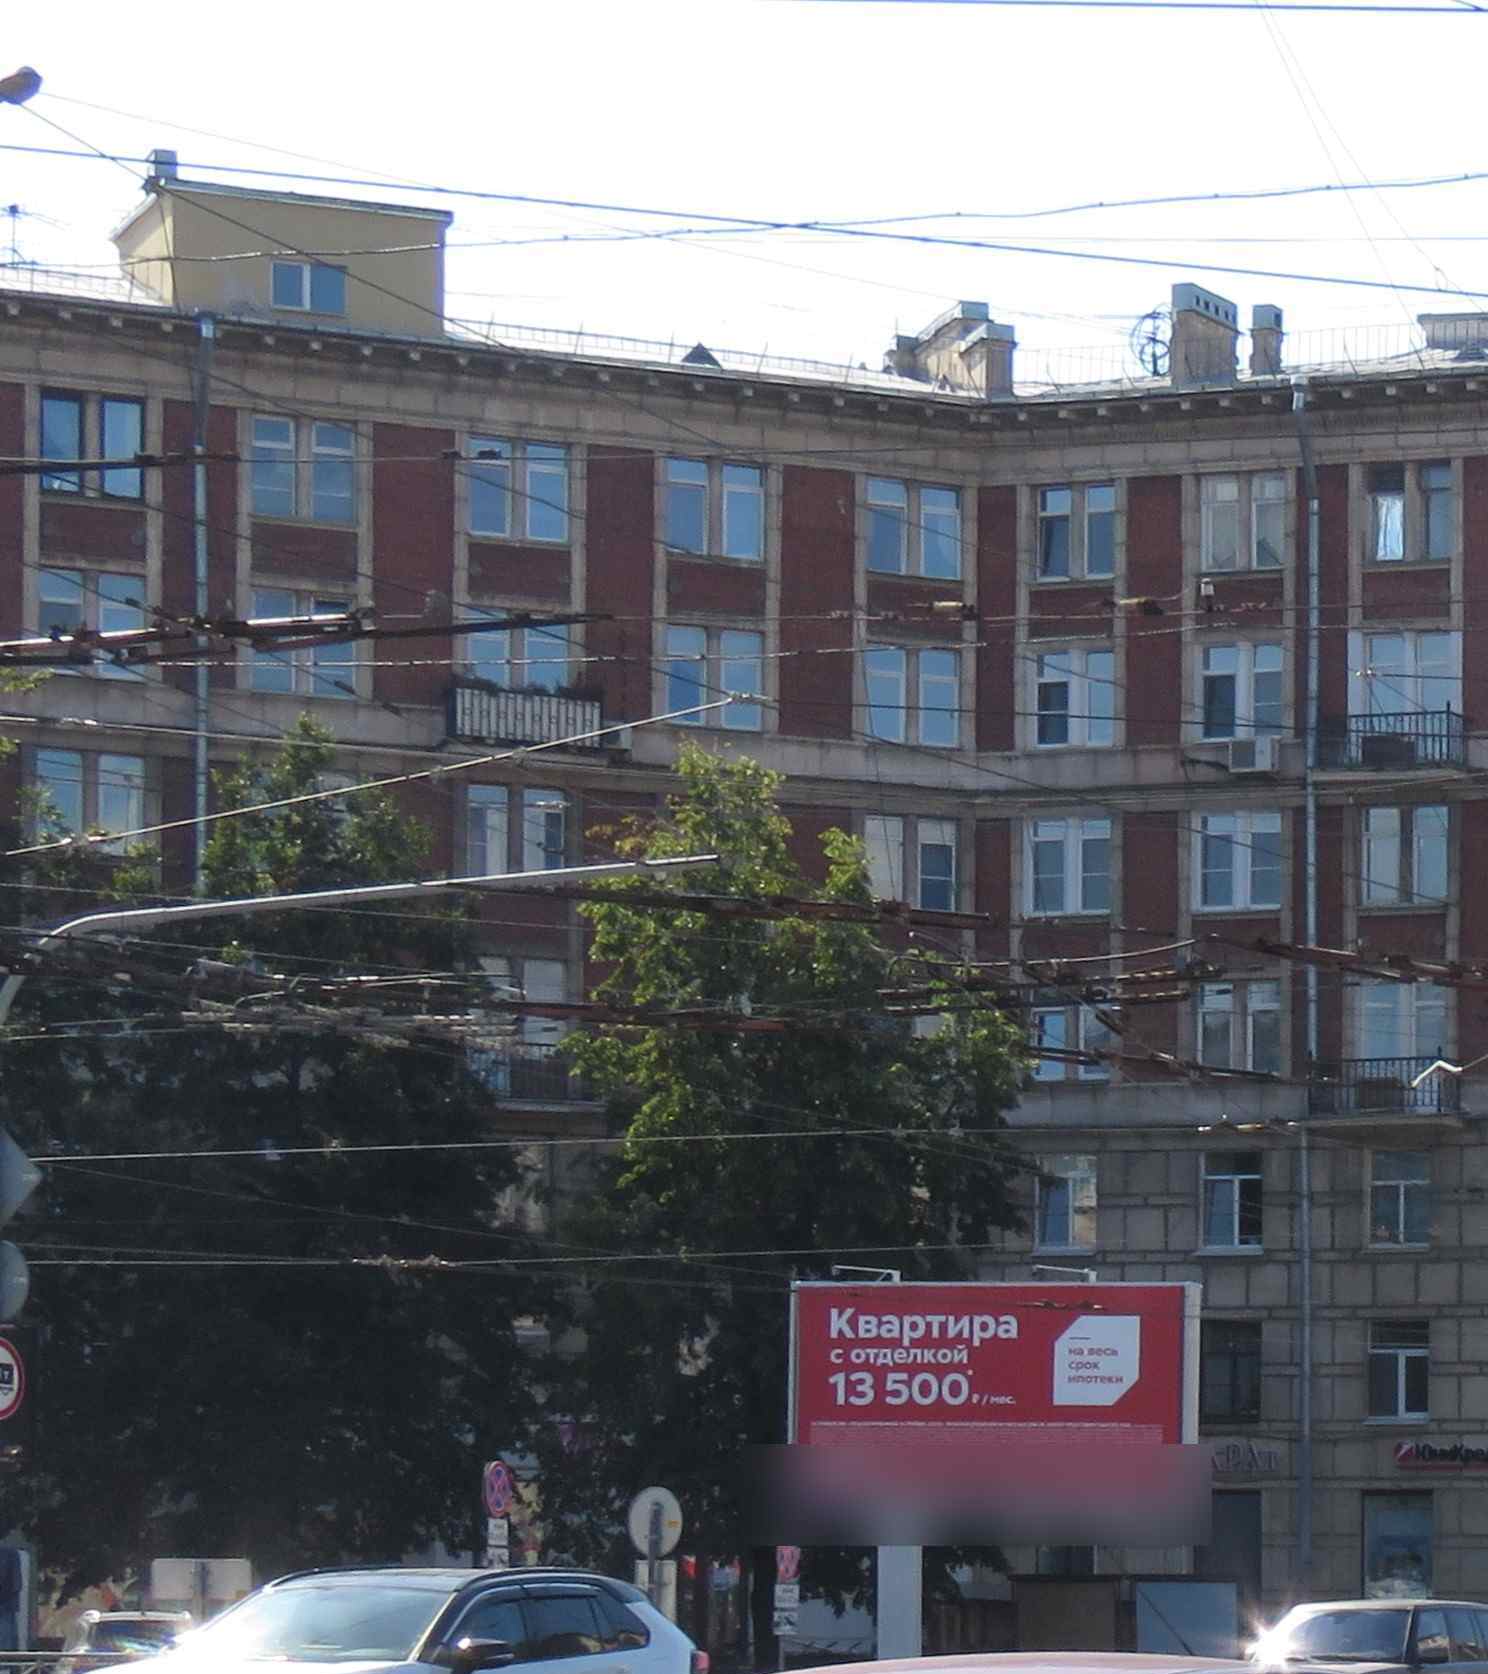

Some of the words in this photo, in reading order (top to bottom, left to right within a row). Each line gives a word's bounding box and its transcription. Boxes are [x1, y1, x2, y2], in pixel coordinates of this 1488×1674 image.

[829, 1307, 1019, 1347] Квартира
[829, 1349, 844, 1364] с
[850, 1344, 969, 1366] отделкой
[1068, 1361, 1100, 1373] срок
[828, 1372, 875, 1406] 13
